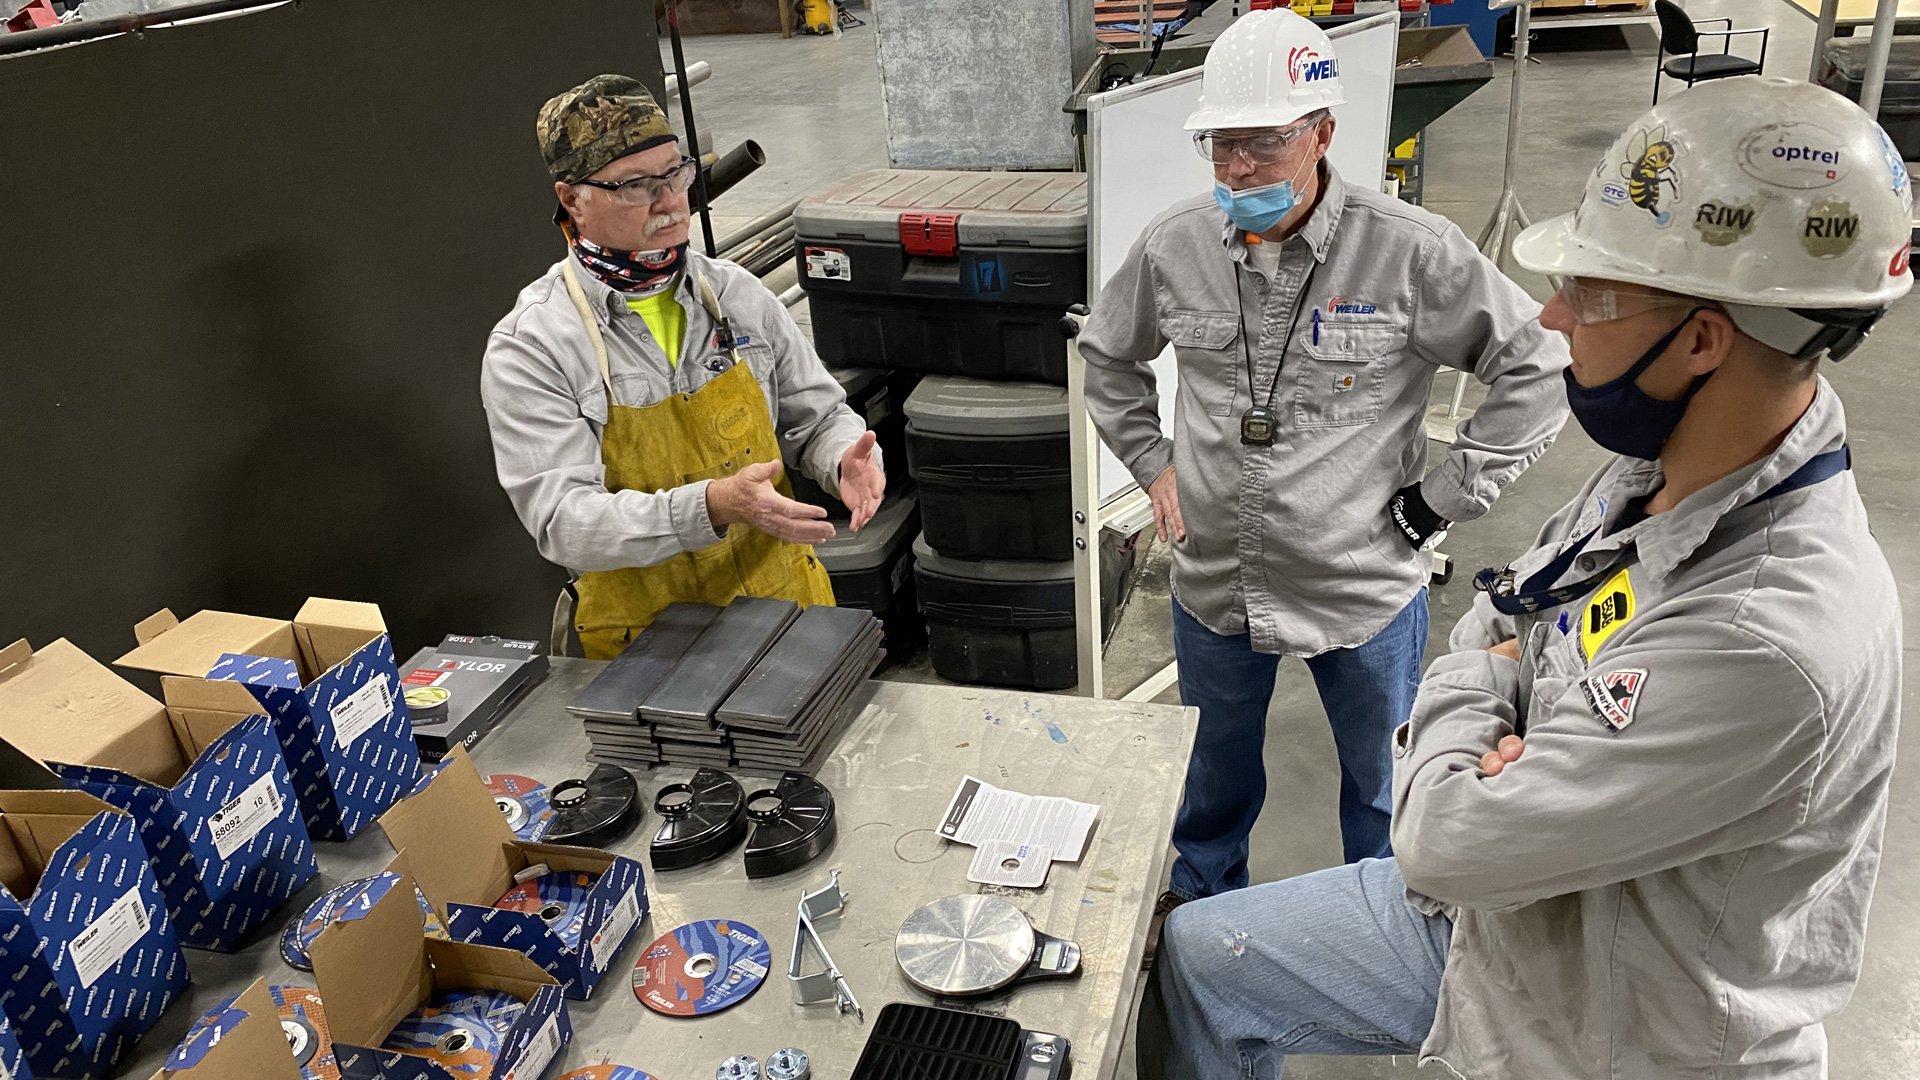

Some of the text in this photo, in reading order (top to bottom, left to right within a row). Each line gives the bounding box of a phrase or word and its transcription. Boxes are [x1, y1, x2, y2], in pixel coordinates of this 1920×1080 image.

[1304, 59, 1339, 82] WEIL
[1772, 145, 1840, 166] optrel
[1603, 186, 1626, 198] OTC
[1696, 203, 1755, 230] RIW
[1805, 217, 1859, 238] RIW
[1336, 305, 1376, 314] WEILER
[1392, 503, 1420, 540] WEILER
[1601, 596, 1613, 629] ESAB
[437, 659, 506, 673] TAYLOR
[337, 701, 354, 716] WEILER
[1609, 708, 1624, 724] FR
[222, 798, 241, 816] TIGER
[254, 797, 264, 808] 10
[215, 816, 241, 839] 58092
[77, 928, 98, 949] WEILER
[728, 930, 759, 946] TIGER
[650, 994, 675, 1009] WEILER
